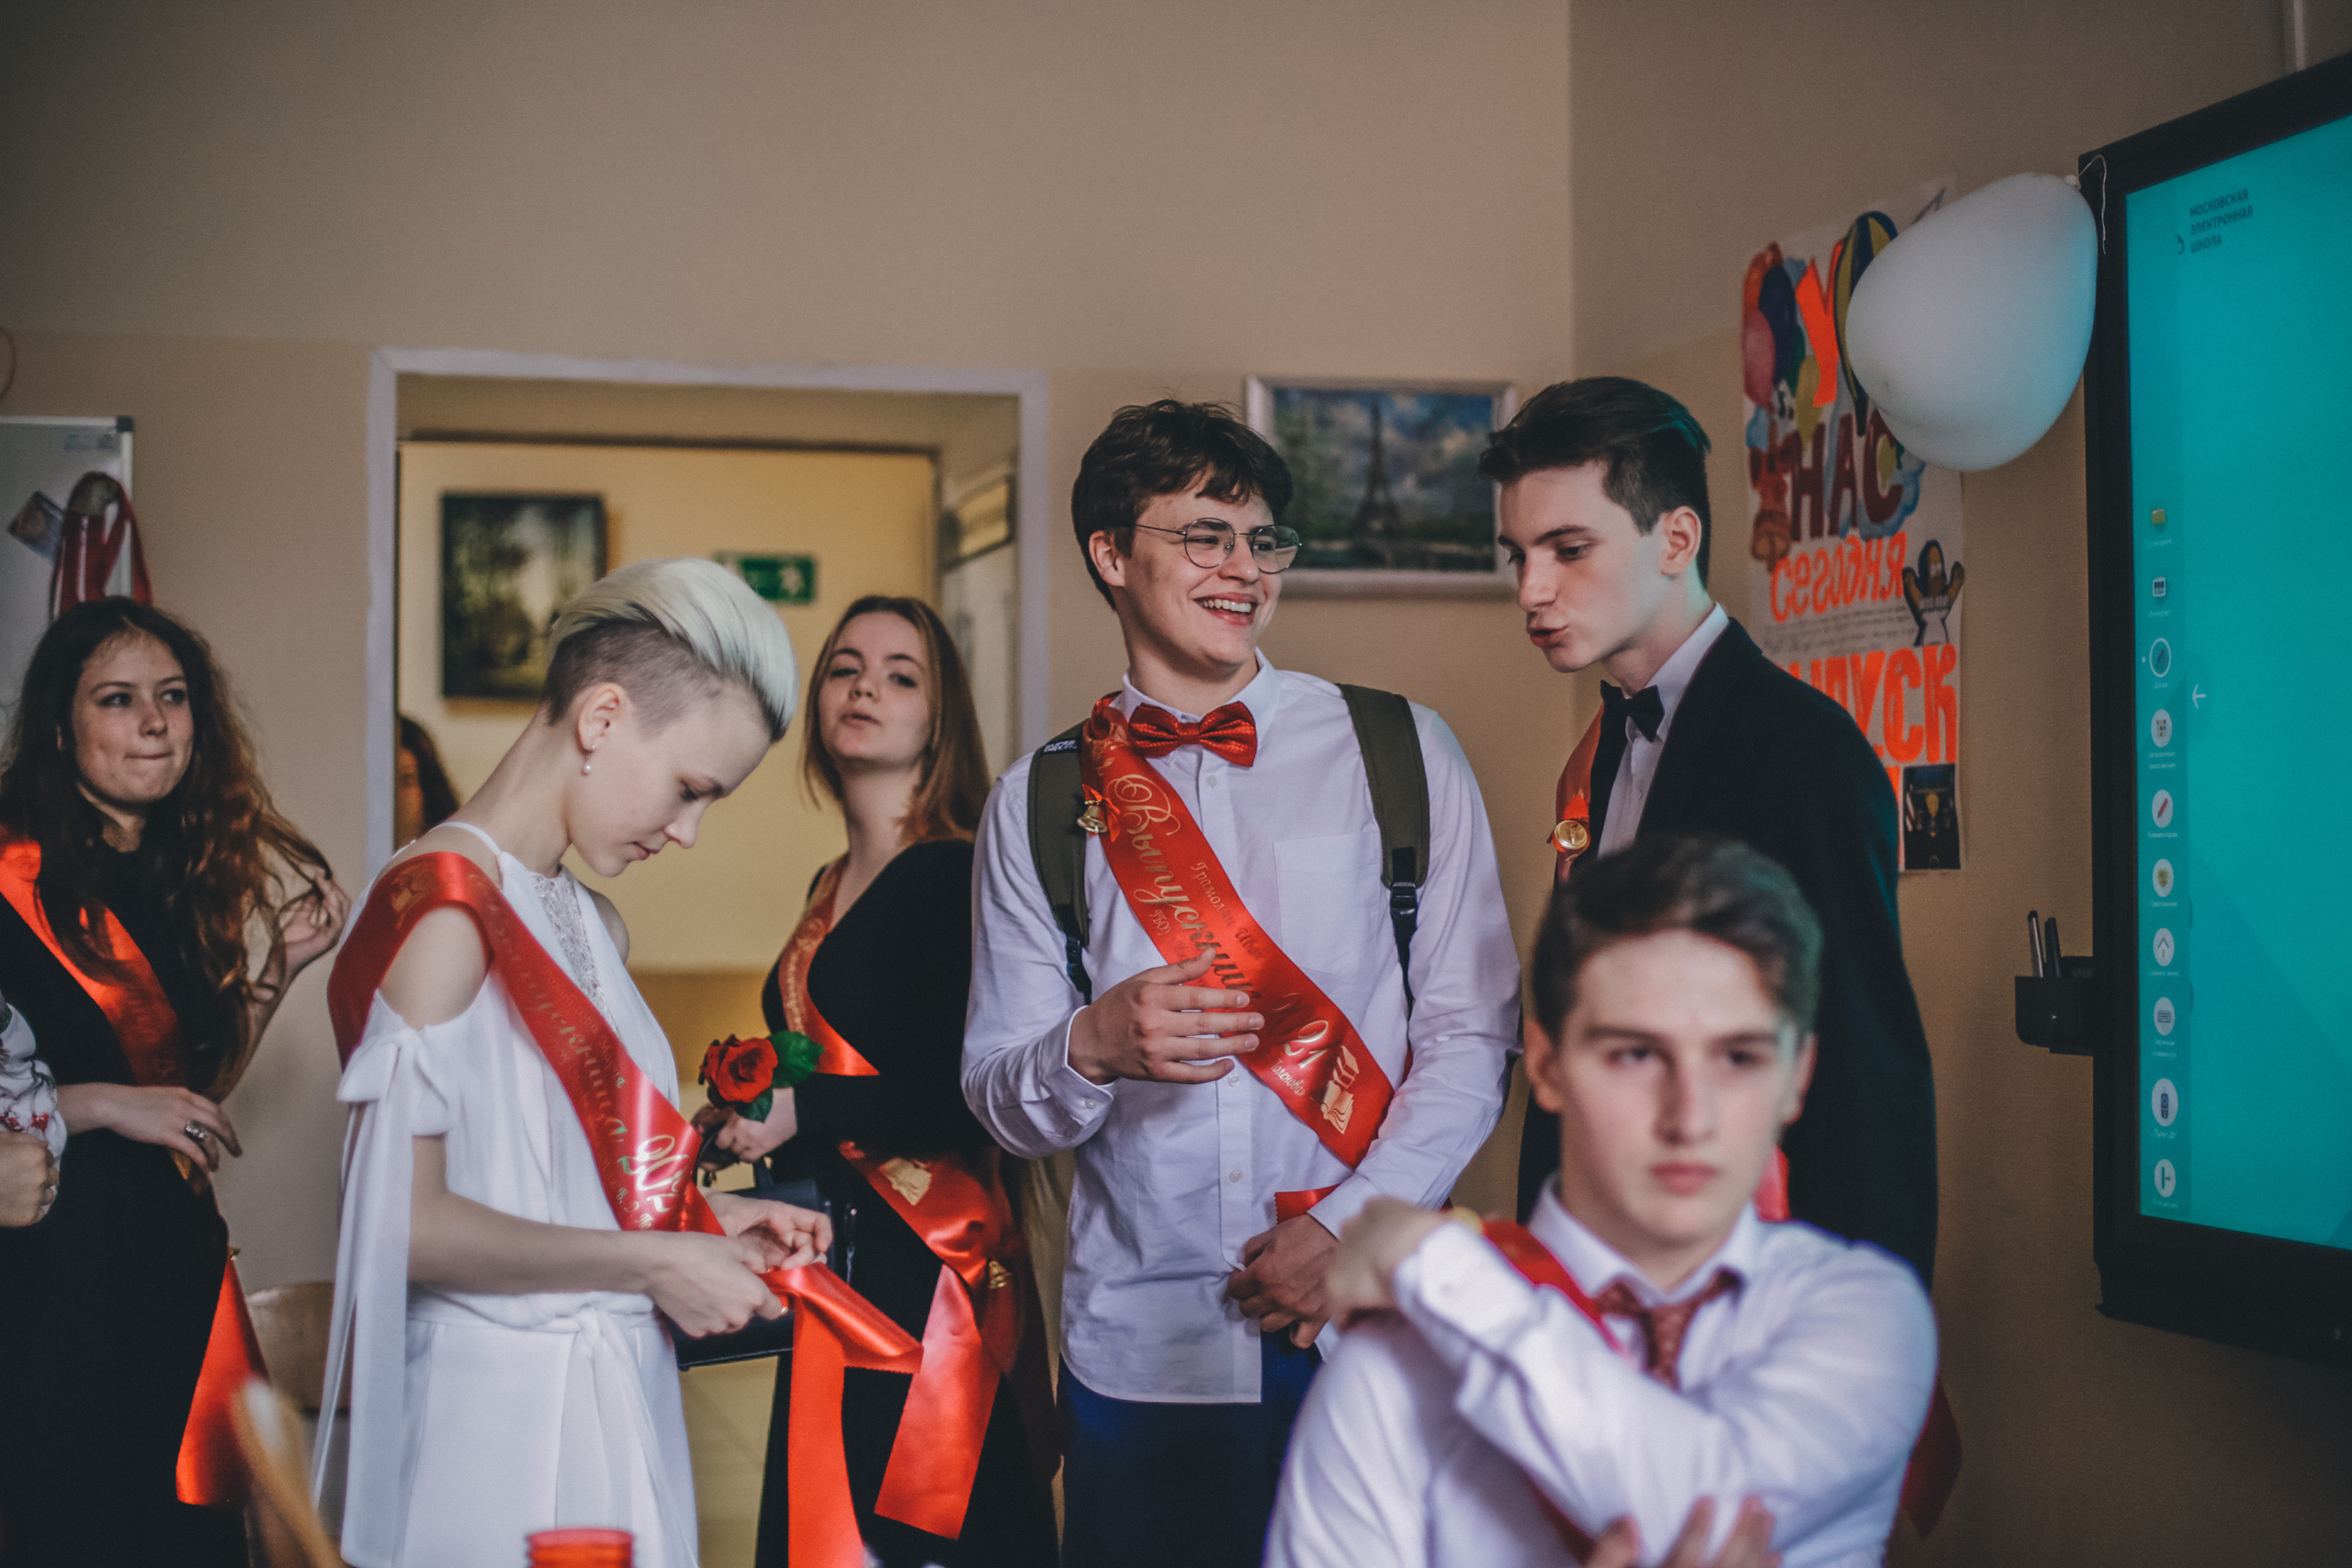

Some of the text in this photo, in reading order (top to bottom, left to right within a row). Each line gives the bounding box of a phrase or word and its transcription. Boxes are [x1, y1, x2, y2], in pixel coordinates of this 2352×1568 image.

[2189, 188, 2249, 218] МОСКОВСКАЯ
[2190, 205, 2254, 235] ЭЛЕКТРОННАЯ
[2190, 233, 2222, 254] ШКОЛА
[1790, 409, 1904, 542] НАС
